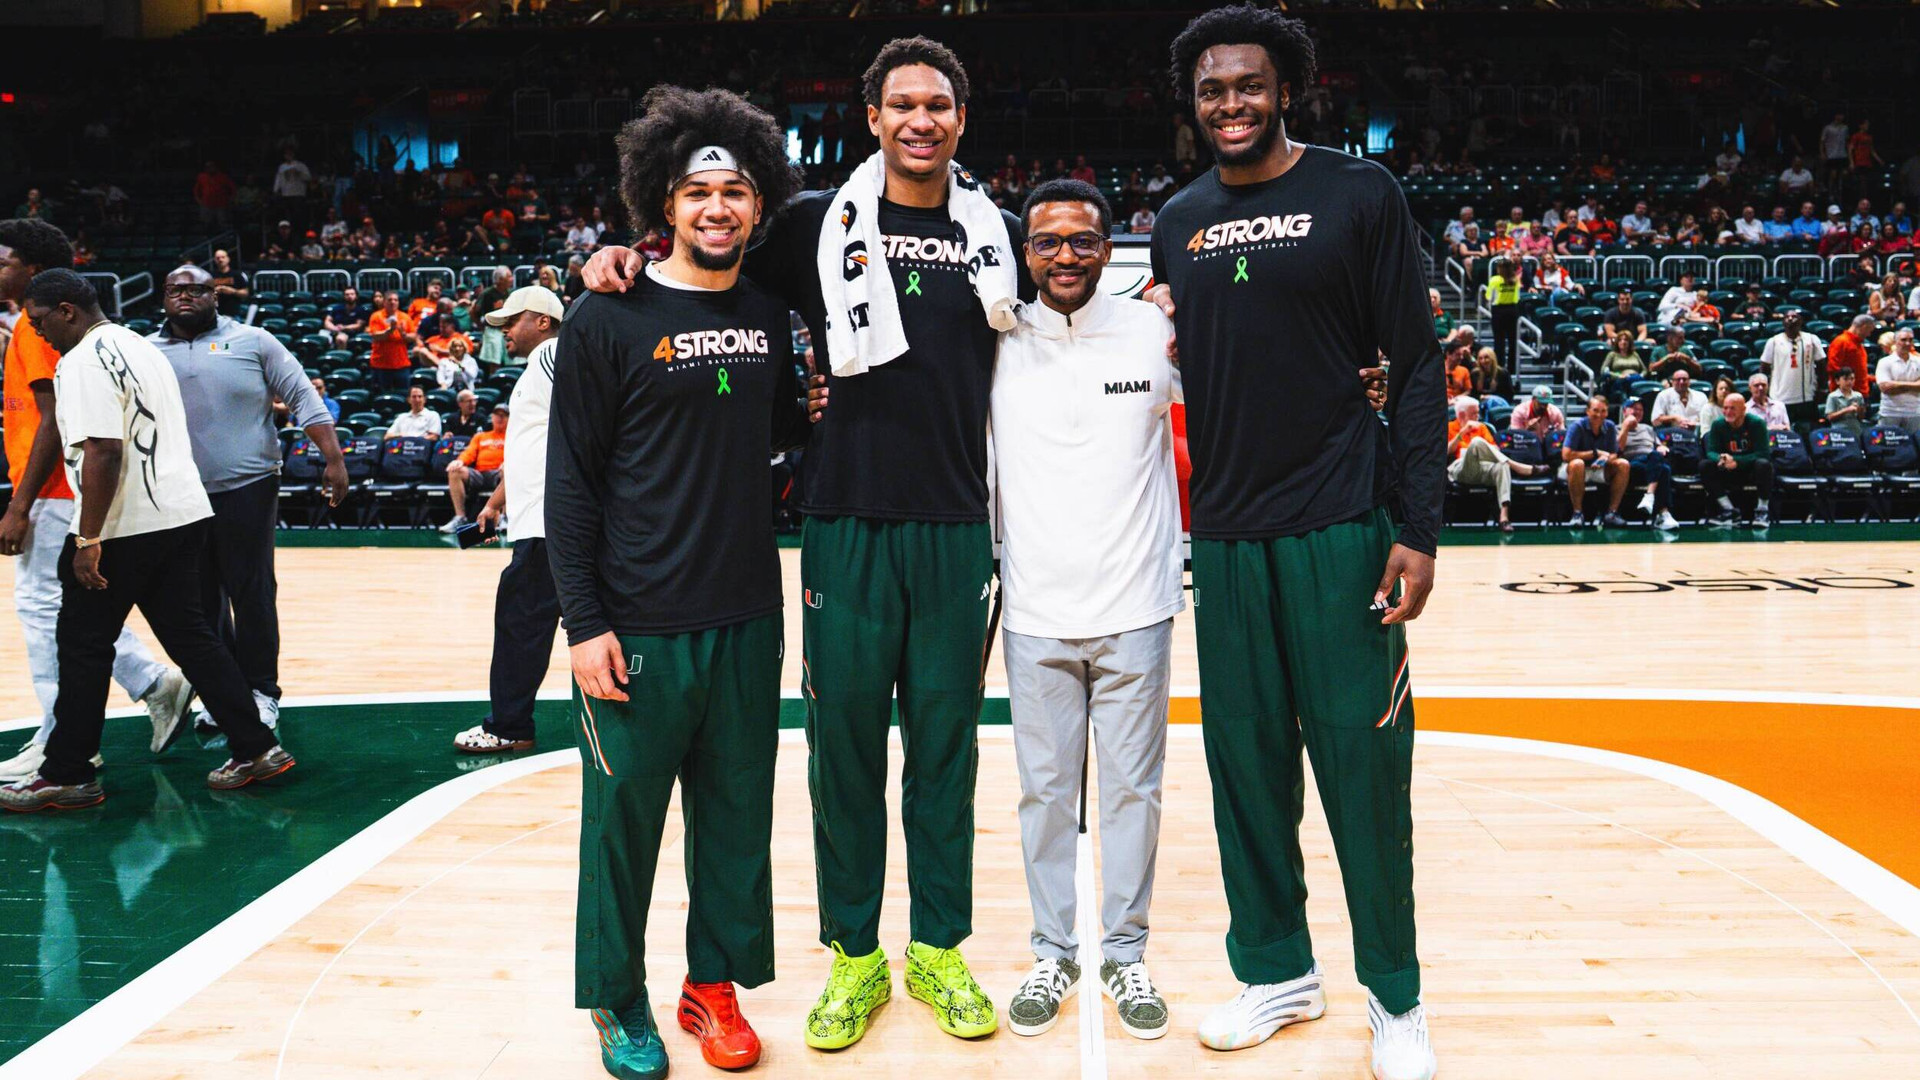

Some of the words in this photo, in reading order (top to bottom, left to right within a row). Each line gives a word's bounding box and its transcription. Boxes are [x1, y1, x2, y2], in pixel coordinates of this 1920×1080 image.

[1186, 213, 1312, 253] 4STRONG
[1193, 251, 1222, 262] MIAMI
[1230, 241, 1298, 254] BASKETBALL
[900, 262, 966, 272] BASKETBAL
[652, 328, 768, 362] 4STRONG
[667, 362, 701, 372] MIAMI
[708, 357, 766, 365] BASKETBALL
[1104, 380, 1150, 394] MIAMI
